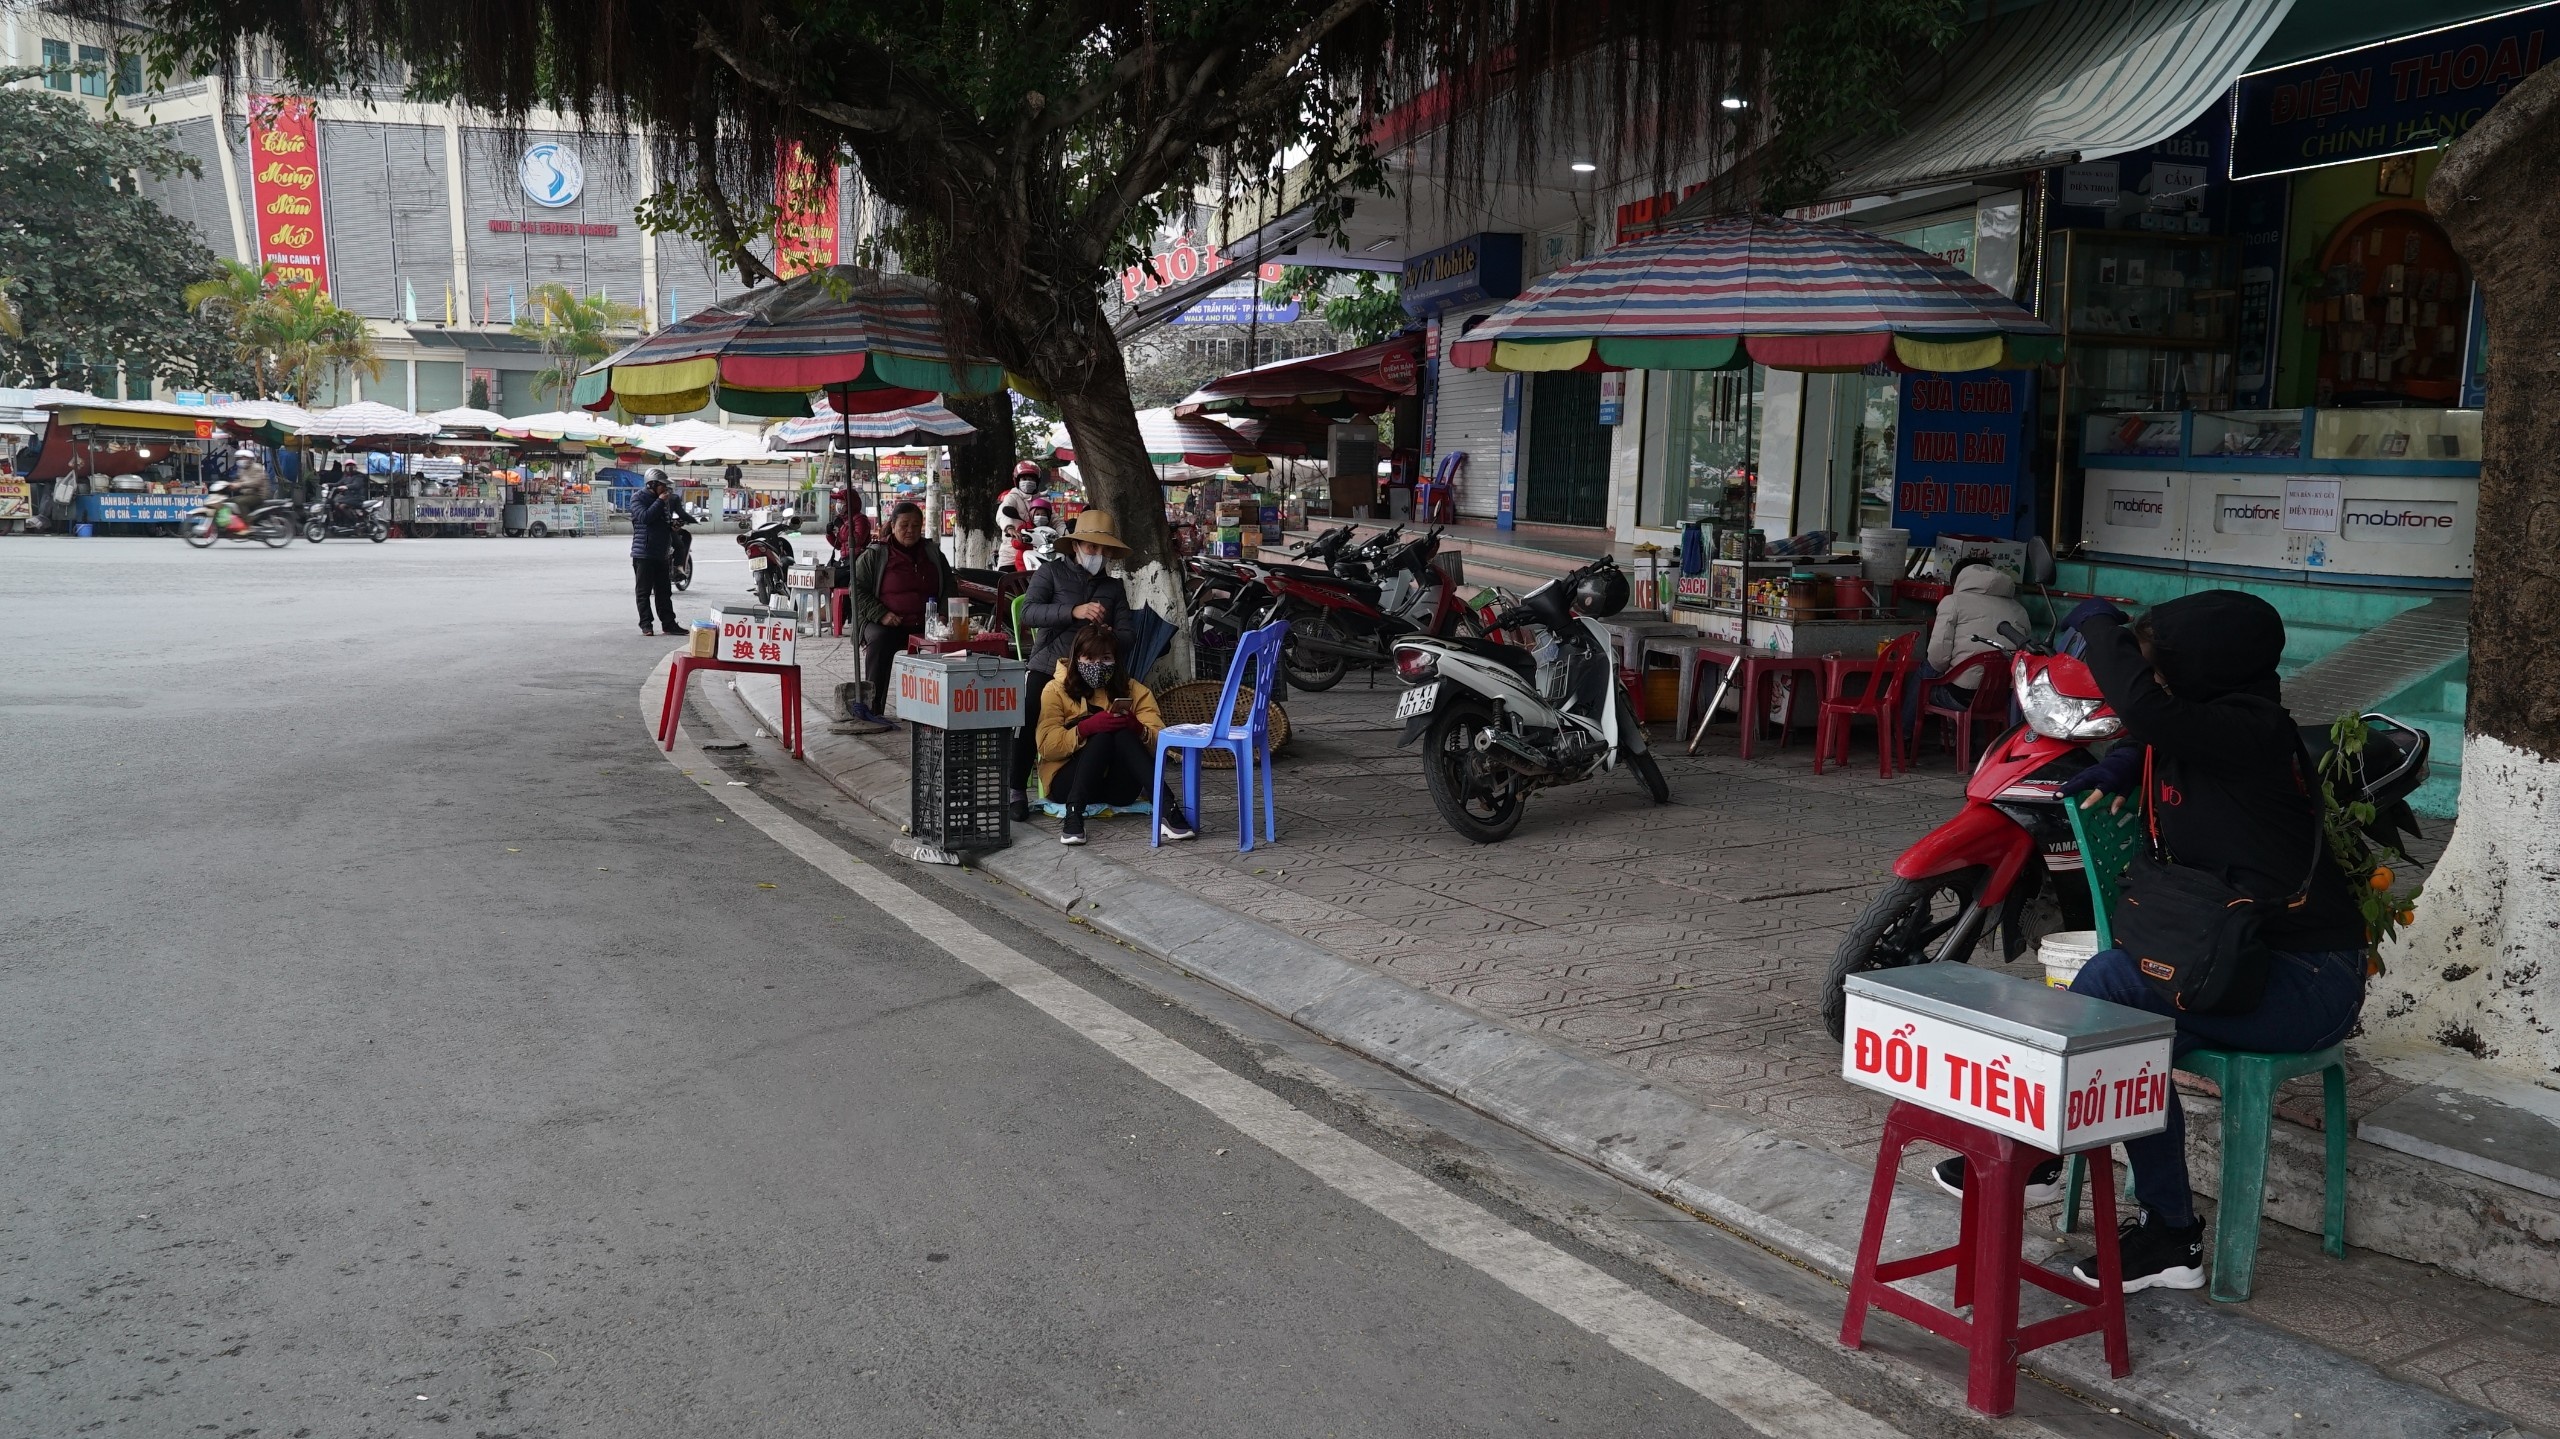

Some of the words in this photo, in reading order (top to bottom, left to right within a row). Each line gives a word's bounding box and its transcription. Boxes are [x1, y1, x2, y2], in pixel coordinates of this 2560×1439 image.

[2271, 66, 2373, 128] ĐIỆN
[2390, 29, 2544, 96] THOẠI
[261, 131, 305, 156] Chúc
[2302, 124, 2386, 158] CHÍNH
[258, 161, 316, 190] Mừng
[270, 223, 314, 248] Mới
[540, 222, 575, 235] CENTER
[578, 224, 618, 237] MARKET
[289, 254, 310, 265] CANH
[1434, 245, 1476, 281] Mobile
[1912, 372, 1954, 412] SỬA
[1959, 377, 2013, 414] CHỮA
[1913, 431, 1958, 463] MUA
[1963, 427, 2006, 464] BÁN
[1900, 476, 1949, 519] ĐIỆN
[1954, 482, 2012, 521] THOẠI
[2223, 504, 2280, 520] mobifone
[2308, 507, 2334, 518] THOẠI
[2346, 510, 2453, 528] mobifone
[1636, 580, 1659, 609] KE
[725, 617, 752, 638] ĐỔI
[757, 621, 793, 641] TIỀN
[733, 640, 781, 662] 换钱
[954, 678, 978, 712] ĐỔI
[1399, 698, 1433, 717] 101.26
[1406, 685, 1433, 703] 14-K1
[1854, 1023, 1928, 1090] ĐỔI
[1944, 1054, 2046, 1131] TIỀN
[2067, 1069, 2106, 1131] ĐỔI
[2114, 1061, 2167, 1120] TIỀN
